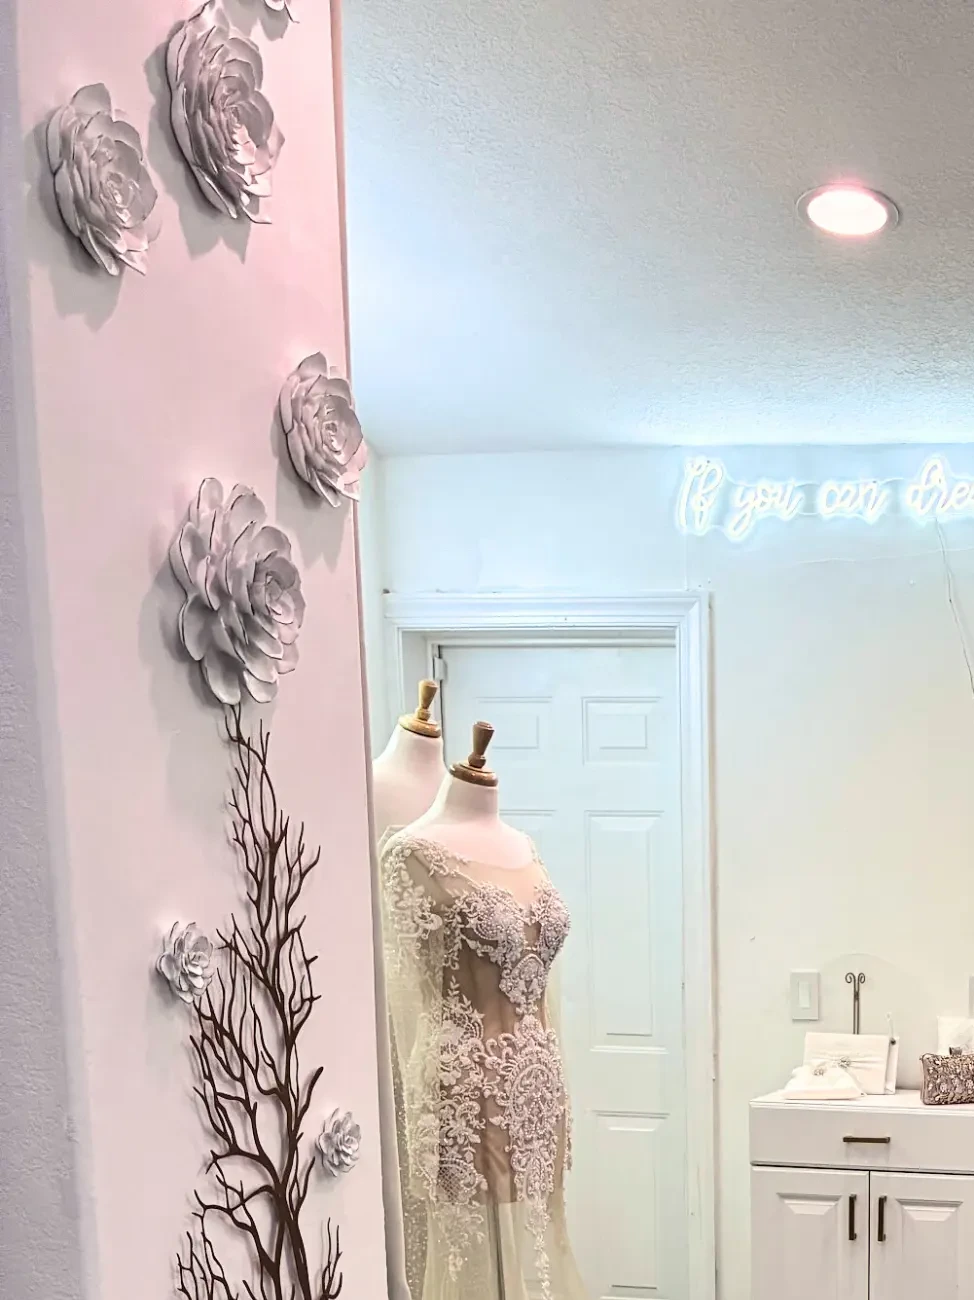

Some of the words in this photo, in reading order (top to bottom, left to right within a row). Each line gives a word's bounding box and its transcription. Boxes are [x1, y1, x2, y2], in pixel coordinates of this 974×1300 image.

[679, 459, 724, 530] If
[728, 484, 802, 538] you
[821, 480, 890, 522] can
